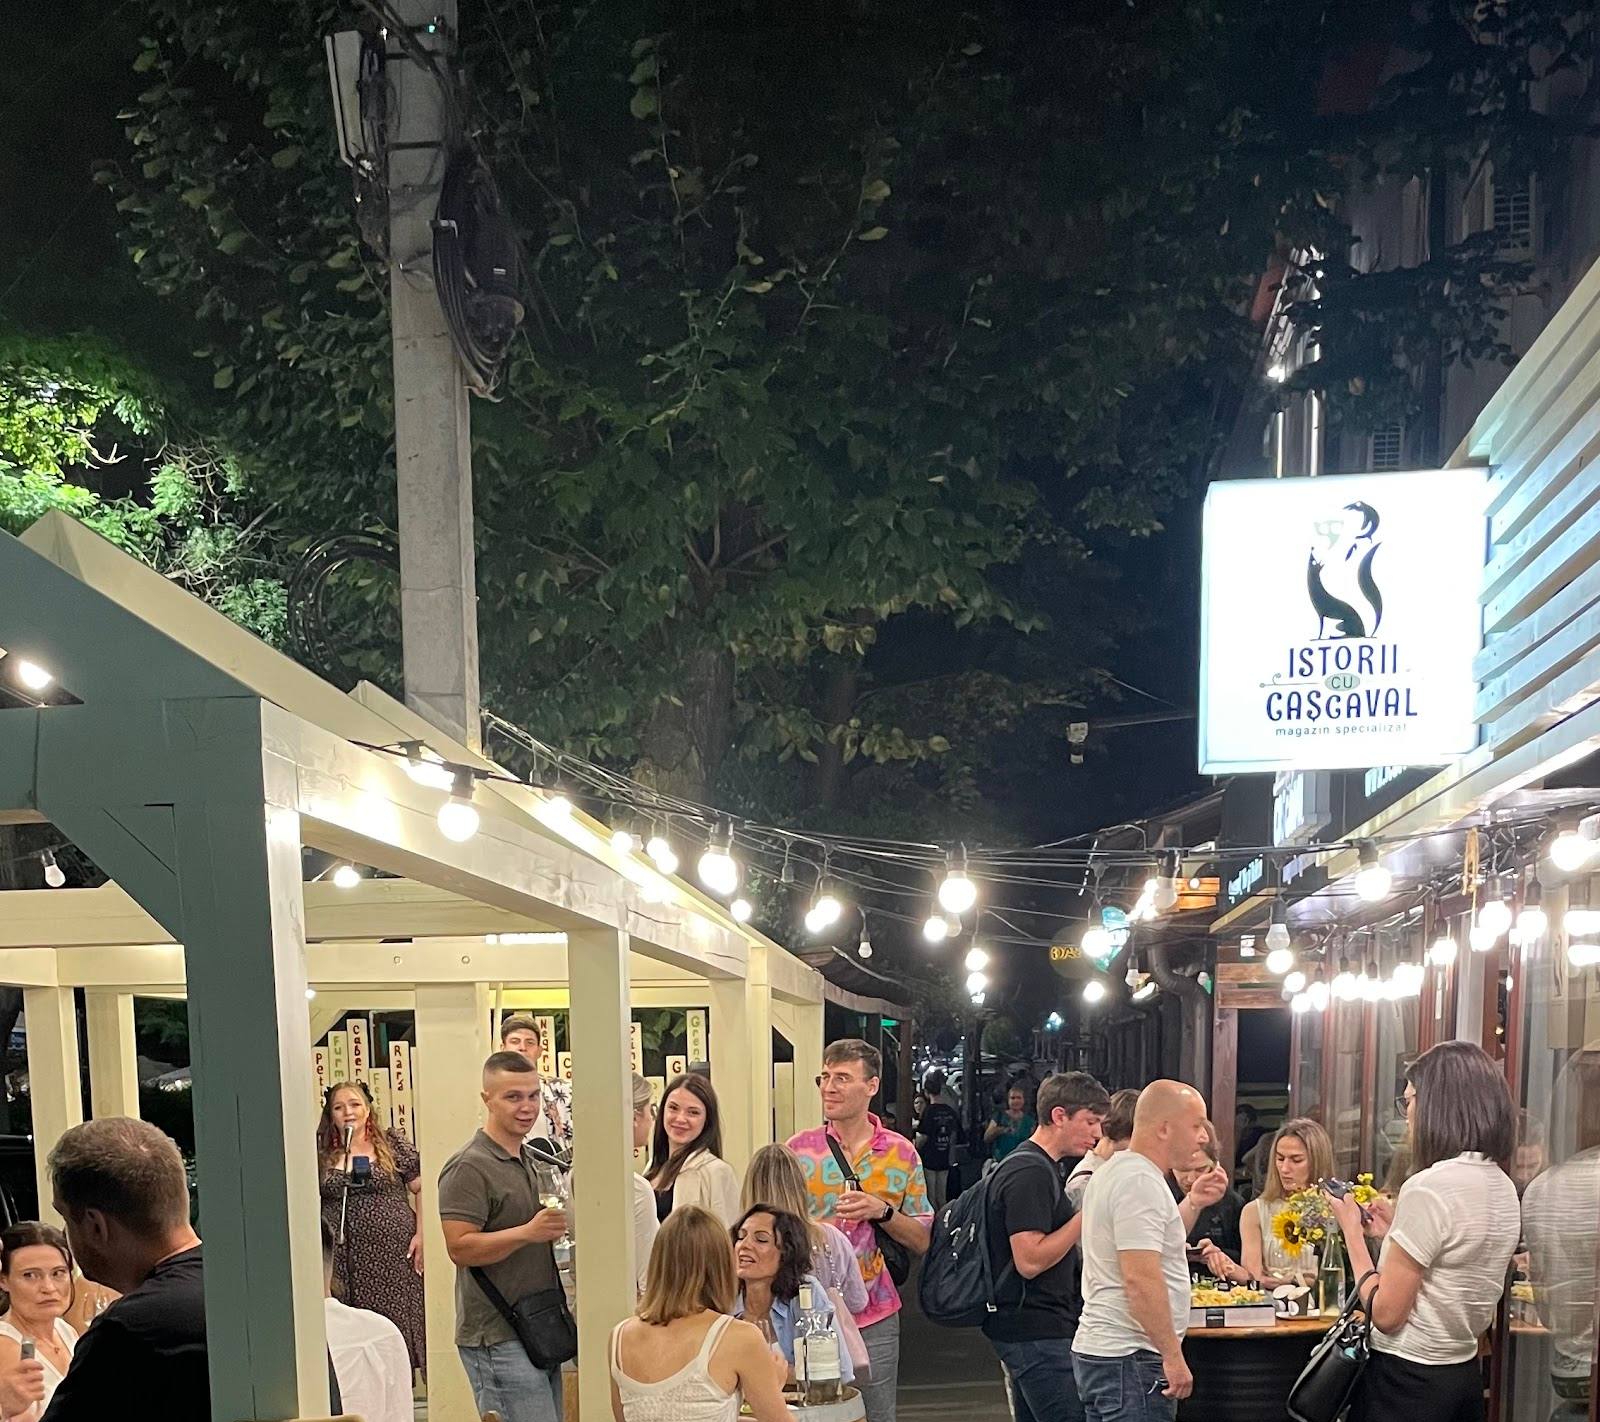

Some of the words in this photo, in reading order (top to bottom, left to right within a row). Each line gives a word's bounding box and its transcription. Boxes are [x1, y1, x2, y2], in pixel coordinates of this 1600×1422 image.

[1289, 643, 1398, 678] ISTORII
[1331, 676, 1353, 689] CU
[1275, 727, 1330, 738] magazin
[1336, 723, 1407, 736] specializat
[540, 1019, 549, 1072] Negru
